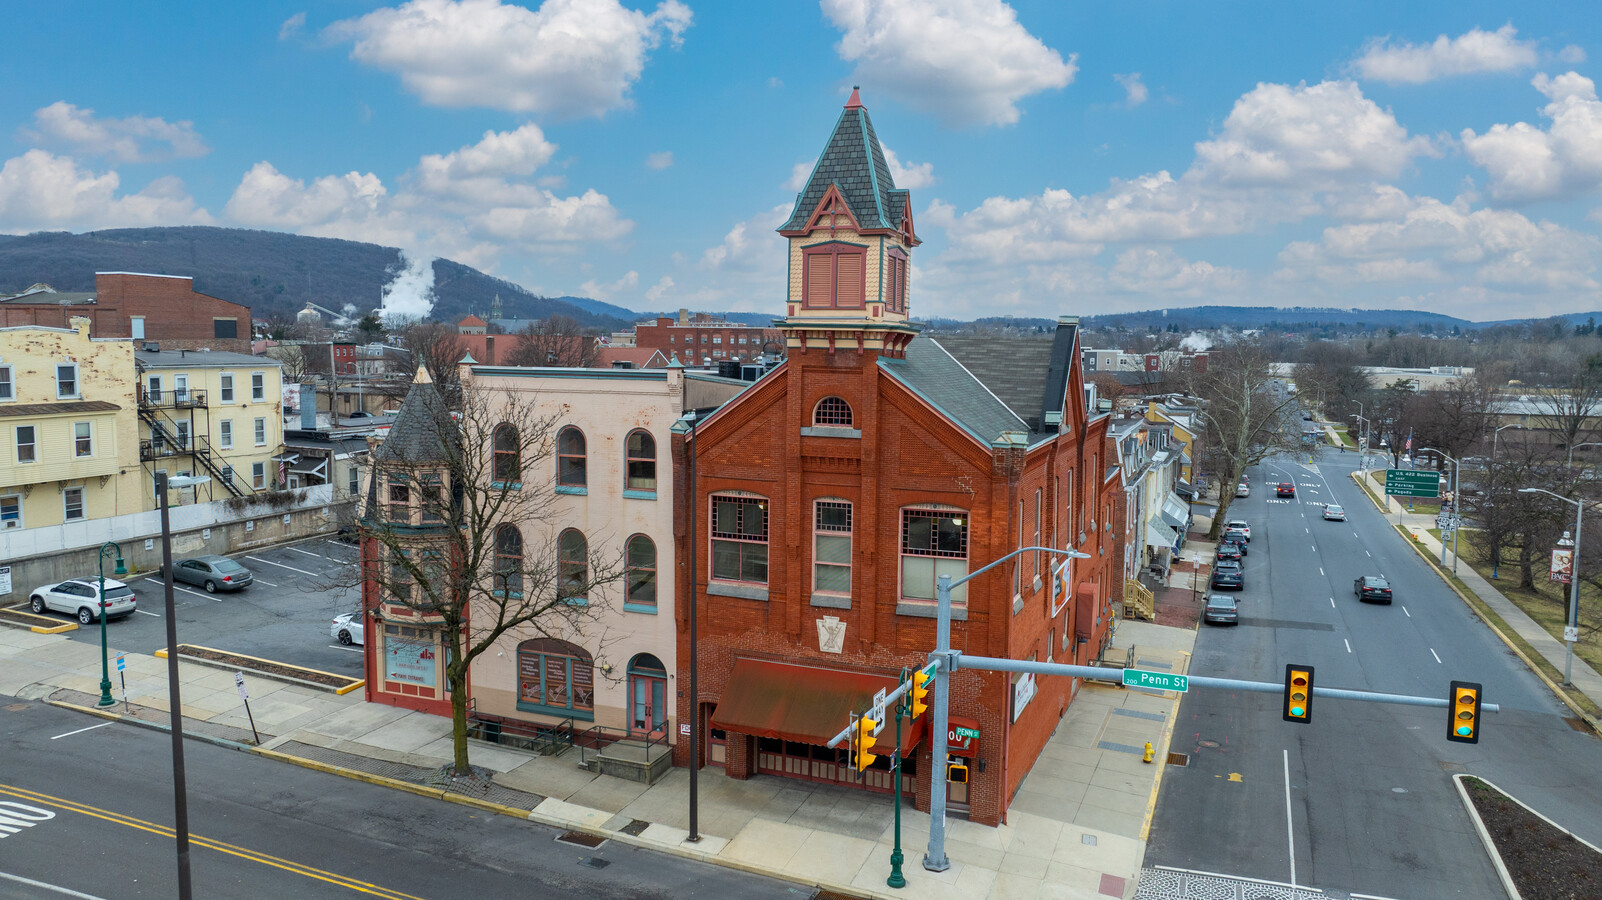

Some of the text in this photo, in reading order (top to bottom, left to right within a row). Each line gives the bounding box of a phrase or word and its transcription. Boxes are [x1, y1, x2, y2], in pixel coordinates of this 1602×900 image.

[1141, 673, 1169, 685] Penn
[1174, 677, 1185, 687] St
[957, 728, 973, 737] PENN
